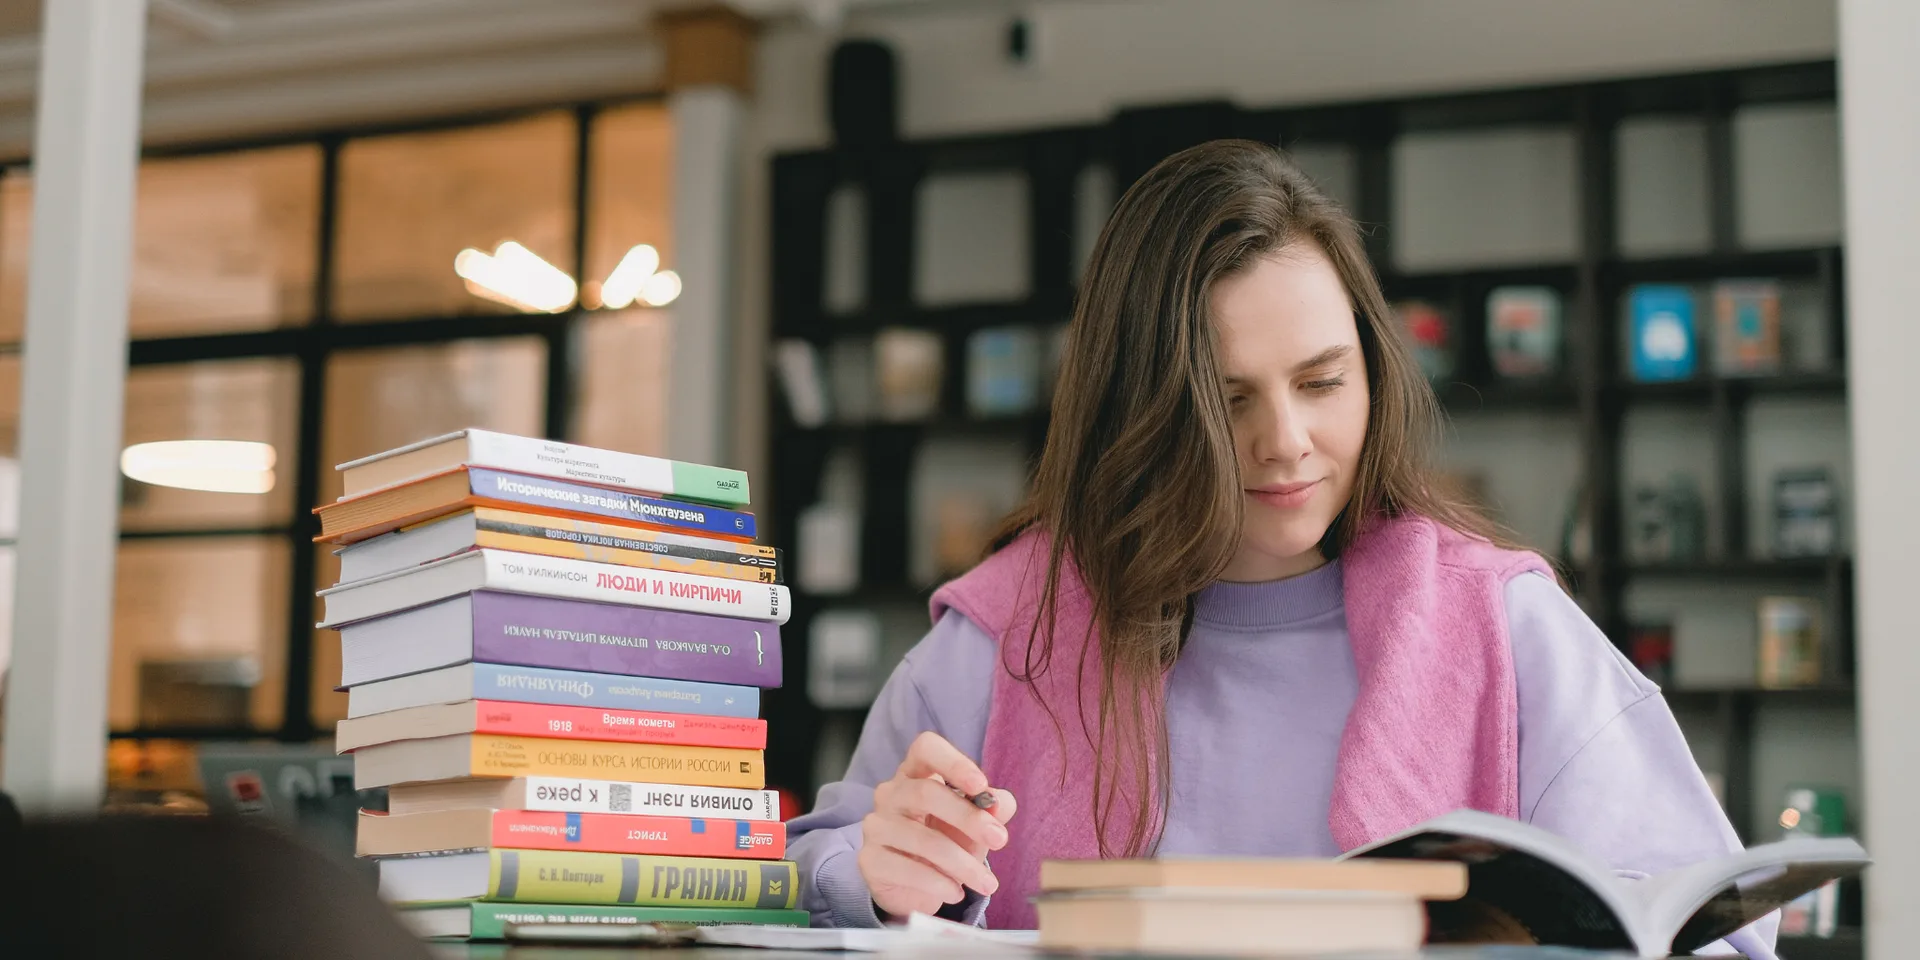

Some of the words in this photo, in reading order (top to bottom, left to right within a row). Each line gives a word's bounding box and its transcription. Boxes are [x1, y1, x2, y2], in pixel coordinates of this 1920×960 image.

[717, 480, 740, 490] GARAGE
[497, 476, 582, 500] Исторические
[582, 494, 628, 511] загадки
[629, 499, 705, 524] Мюнхгаузена
[545, 529, 582, 542] ГОРОДОВ
[583, 535, 614, 547] ЛОГИКА
[615, 538, 669, 553] СОБСТВЕННАЯ
[502, 563, 524, 575] ТОМ
[528, 567, 588, 582] УИЛКИНСОН
[596, 573, 647, 593] ЛЮДИ
[652, 580, 664, 595] И
[669, 581, 742, 604] КИРПИЧИ
[504, 625, 540, 638] НАУКИ
[543, 628, 597, 643] ЦИТАДЕЛЬ
[600, 634, 648, 648] ШТУРМУЯ
[655, 640, 707, 654] ВАЛЬКОВА
[548, 720, 573, 732] 1918
[603, 713, 635, 727] Время
[638, 718, 675, 728] кометы
[538, 751, 587, 767] ОСНОВЫ
[592, 755, 627, 768] КУРСА
[631, 756, 682, 770] ИСТОРИИ
[687, 759, 731, 773] РОССИИ
[537, 783, 582, 801] реке
[627, 830, 668, 841] ТУРИСТ
[740, 836, 773, 845] GARAGE
[651, 866, 748, 901] ГРАНИН
